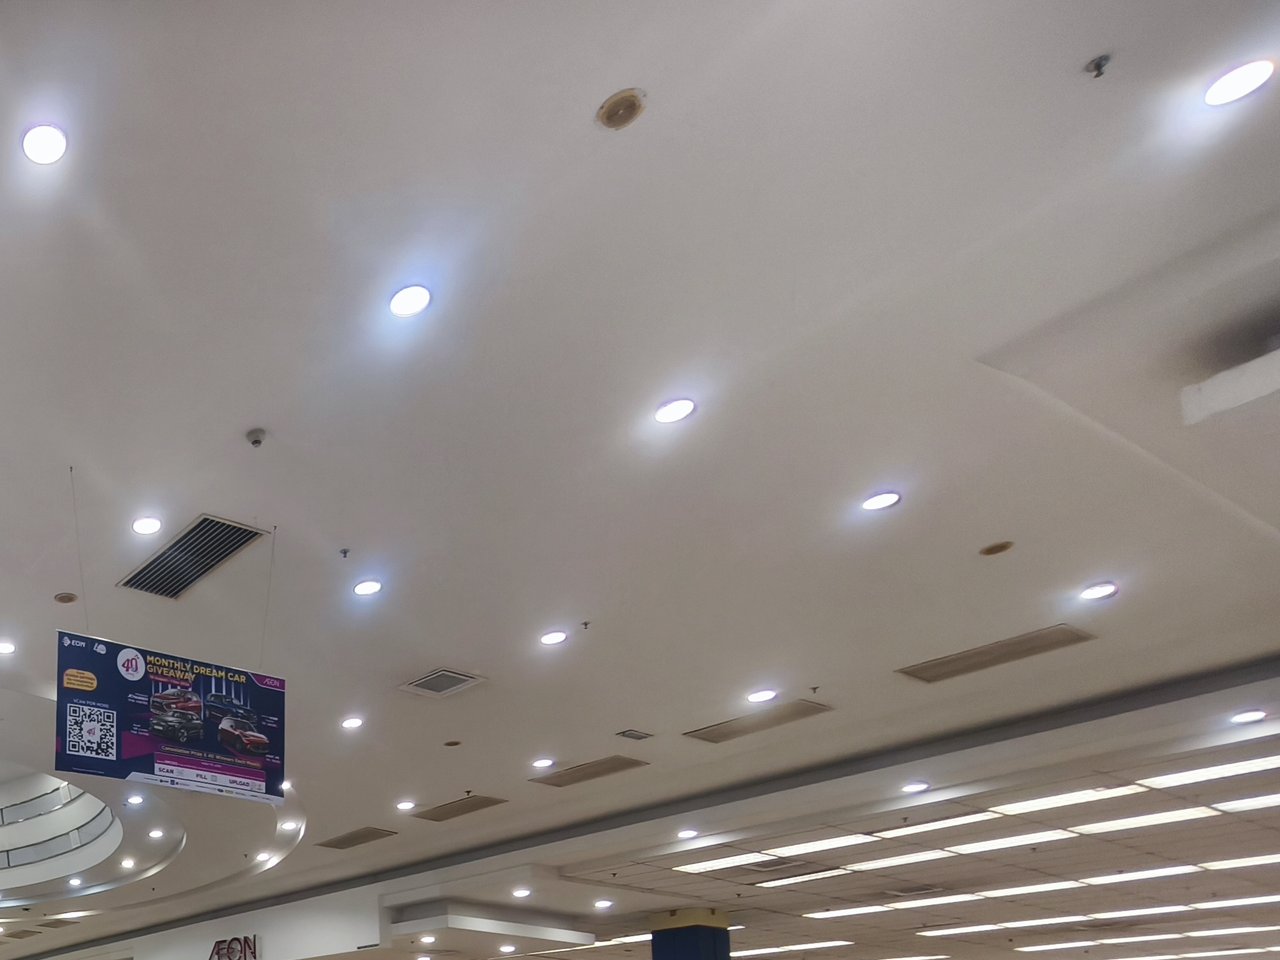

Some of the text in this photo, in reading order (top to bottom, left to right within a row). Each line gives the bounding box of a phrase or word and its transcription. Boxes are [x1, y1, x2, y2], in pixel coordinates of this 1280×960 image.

[146, 655, 247, 684] MONTHLY DREAM CAR
[146, 664, 196, 681] GIVEAWAY
[158, 767, 174, 775] SCAN
[196, 773, 208, 781] FILL
[228, 779, 250, 787] UPLOAD
